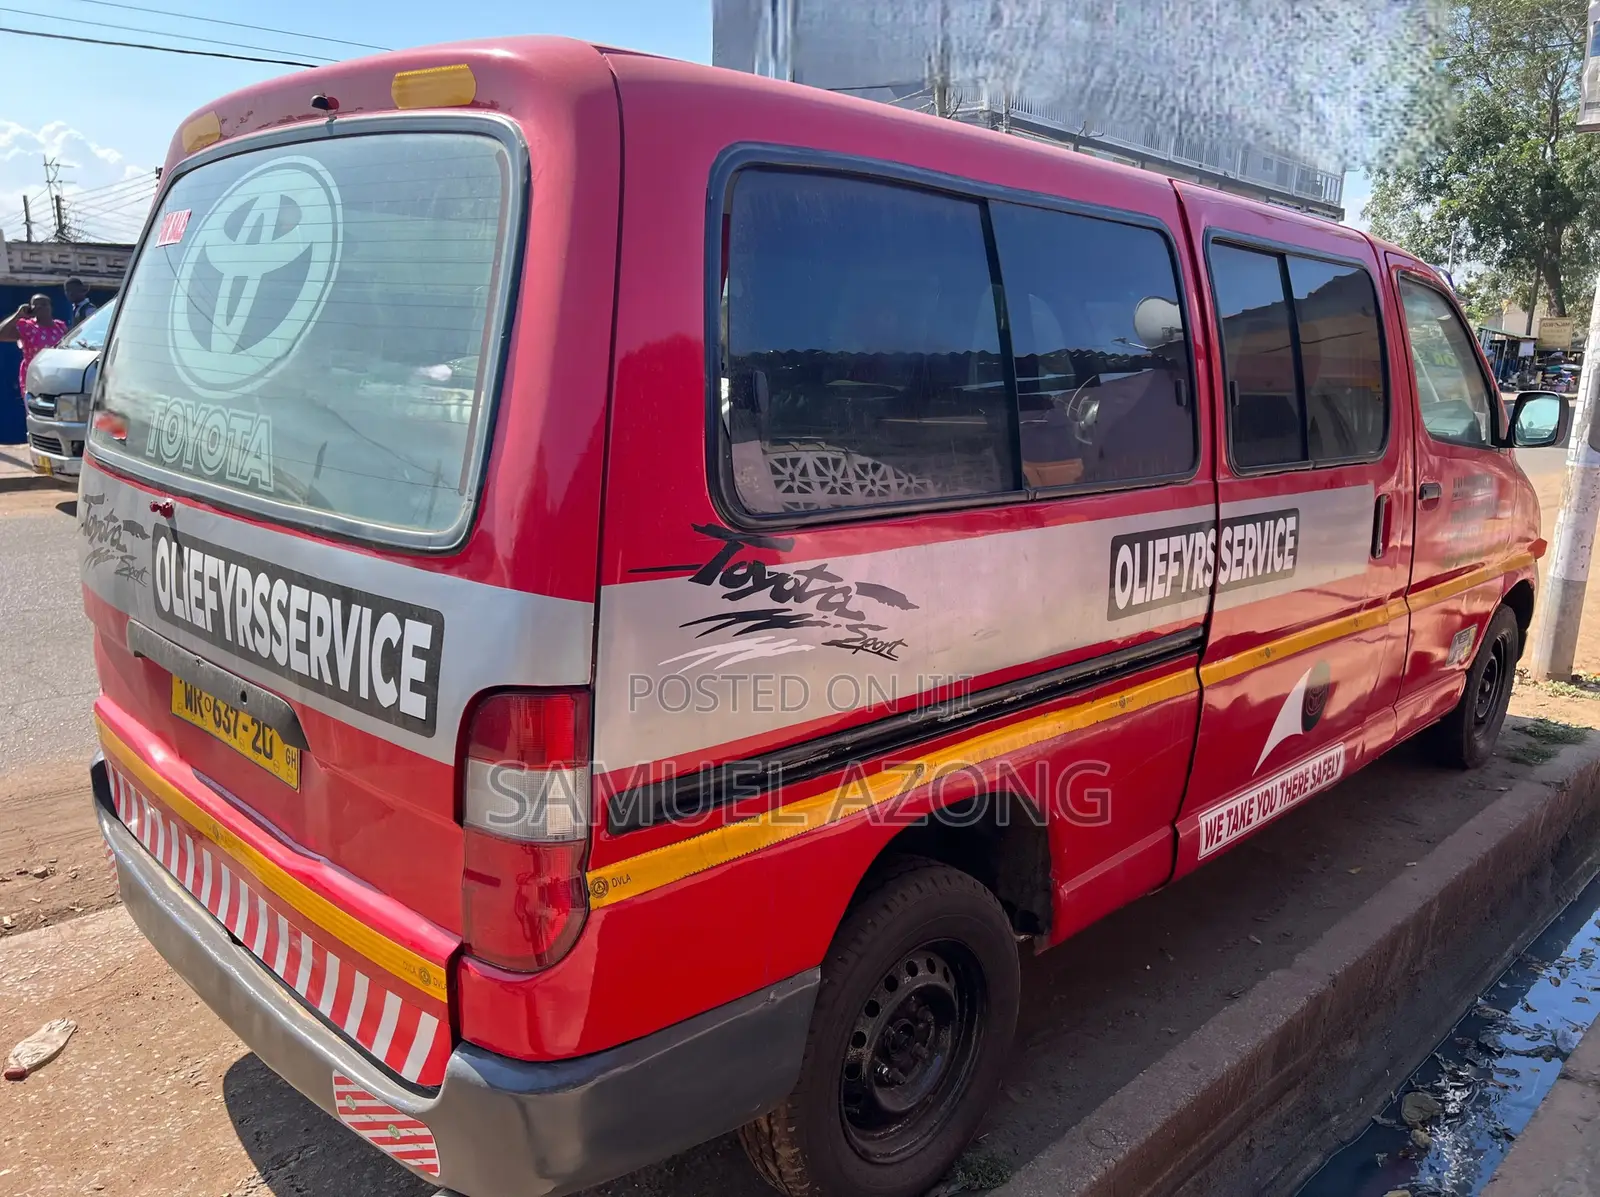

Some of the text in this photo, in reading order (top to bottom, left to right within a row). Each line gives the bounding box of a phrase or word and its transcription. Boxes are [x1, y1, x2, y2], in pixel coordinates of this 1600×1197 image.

[145, 394, 274, 492] TOYOTA
[688, 523, 866, 621] Toyota
[155, 536, 433, 720] OLIEFYRSSERVICE
[822, 623, 908, 661] Sport
[285, 747, 297, 771] GH
[1205, 751, 1342, 850] WE TAKE YOU THERE SAFELY
[611, 874, 632, 888] DVLA
